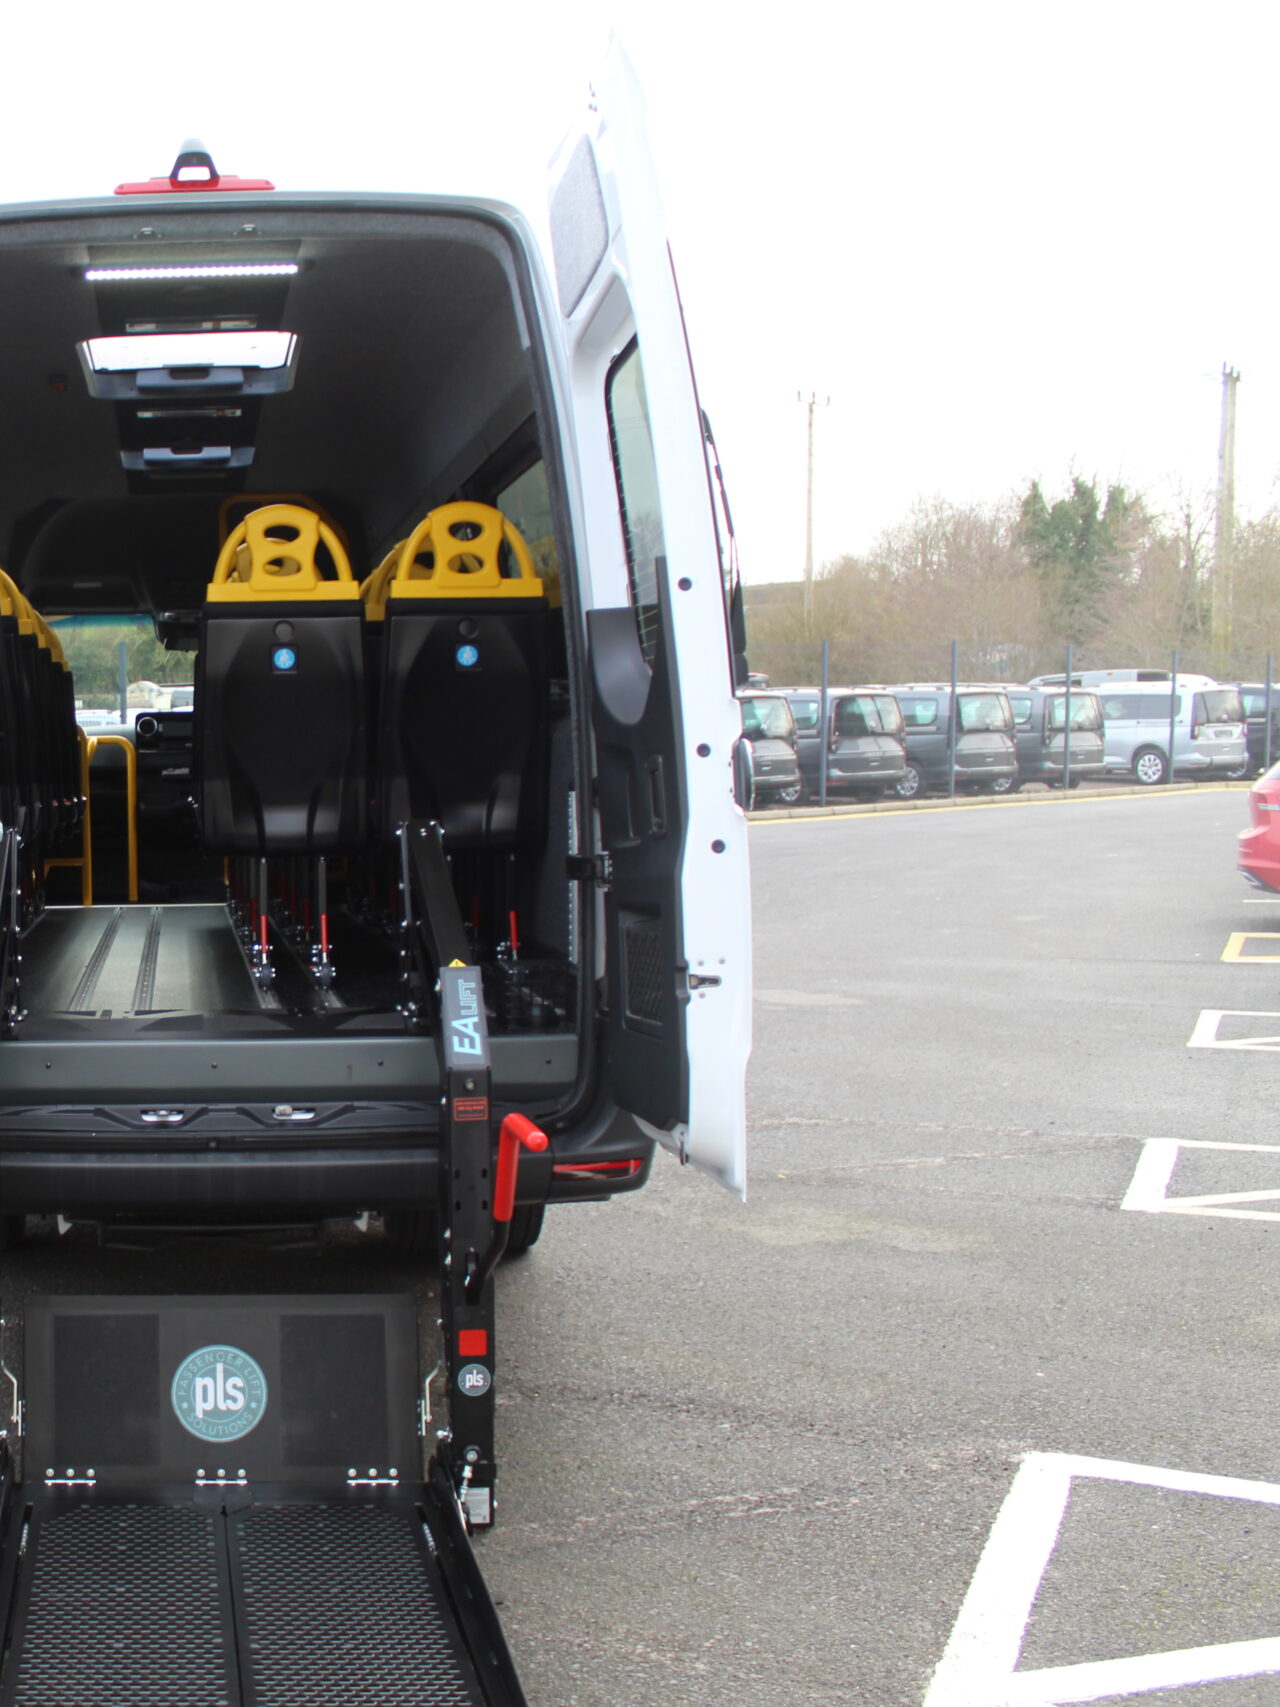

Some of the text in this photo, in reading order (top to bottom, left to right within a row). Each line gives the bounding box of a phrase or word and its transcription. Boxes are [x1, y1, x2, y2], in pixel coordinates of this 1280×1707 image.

[178, 1352, 262, 1396] PASSENGER LIFT
[195, 1362, 245, 1418] pls
[465, 1369, 484, 1389] pls
[187, 1411, 254, 1434] SOLUTIONS
